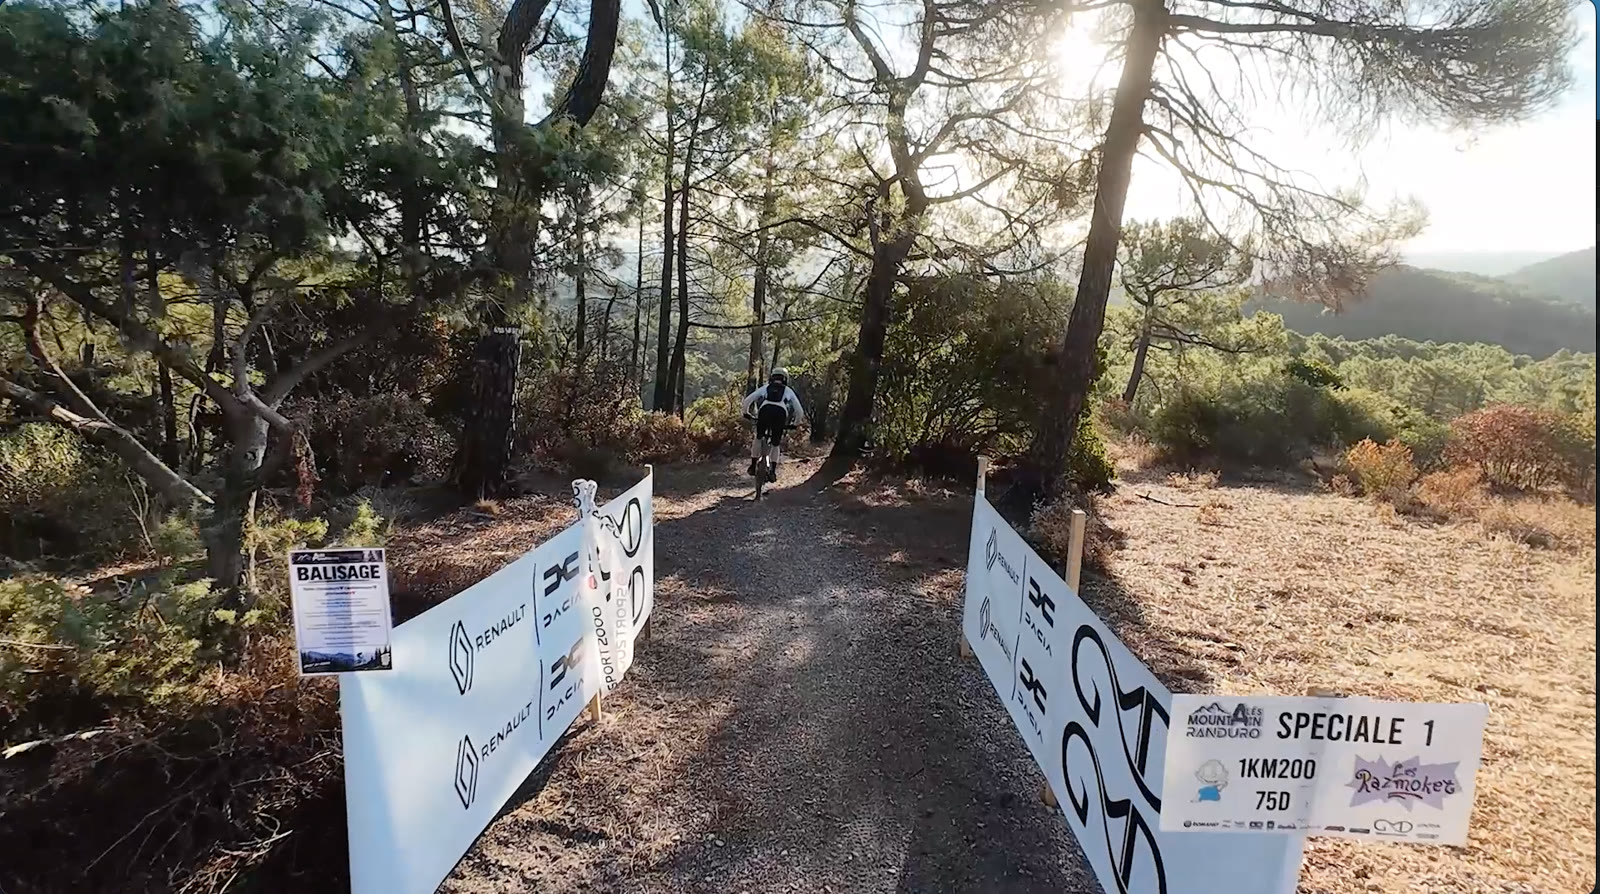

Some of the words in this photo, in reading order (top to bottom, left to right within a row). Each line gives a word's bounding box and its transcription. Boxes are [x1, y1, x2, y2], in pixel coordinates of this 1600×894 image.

[297, 565, 380, 580] BALISAGE
[997, 552, 1020, 586] RENAULT
[475, 604, 526, 651] RENAULT
[544, 592, 581, 628] DACIA
[592, 606, 609, 645] 2000
[989, 623, 1012, 663] RENAULT
[1025, 612, 1052, 657] DACIA
[600, 648, 618, 691] SPORT
[547, 678, 584, 721] DACIA
[1018, 690, 1043, 744] DACIA
[481, 701, 533, 761] RENAULT
[1186, 727, 1261, 739] RANDURO
[1188, 712, 1262, 727] MOUNTAIN
[1277, 712, 1405, 745] SPECIALE
[1423, 720, 1435, 746] 1
[1239, 758, 1316, 779] 1KM200
[1355, 769, 1456, 795] Razmoket
[1256, 791, 1291, 811] 75D
